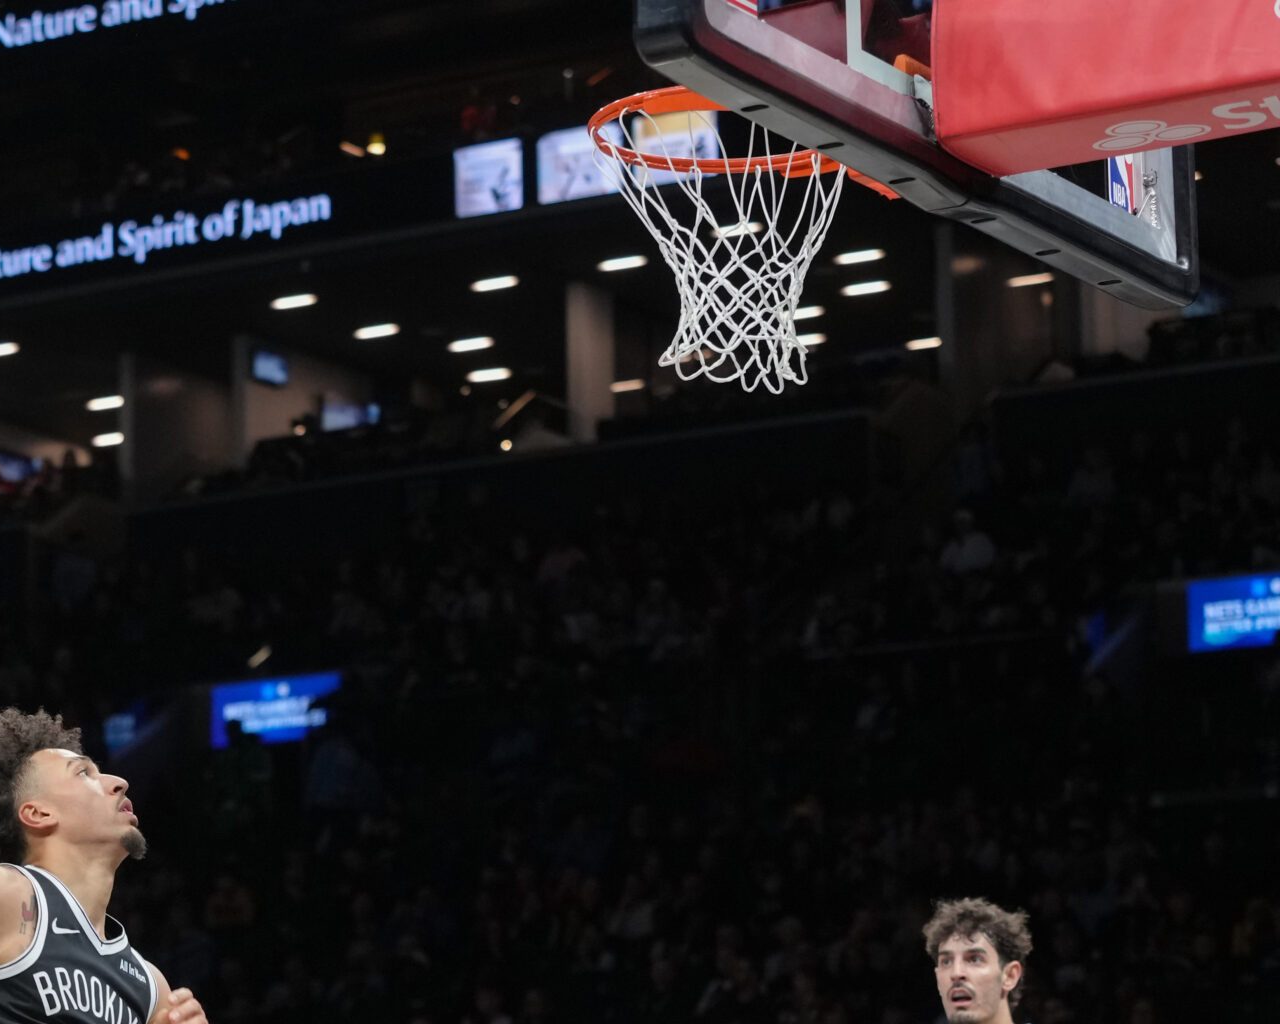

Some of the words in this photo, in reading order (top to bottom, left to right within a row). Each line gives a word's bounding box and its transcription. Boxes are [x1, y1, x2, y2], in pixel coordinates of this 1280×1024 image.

[56, 223, 114, 268] and
[118, 210, 200, 264] Spirit
[201, 201, 241, 242] of
[242, 193, 332, 241] Japan
